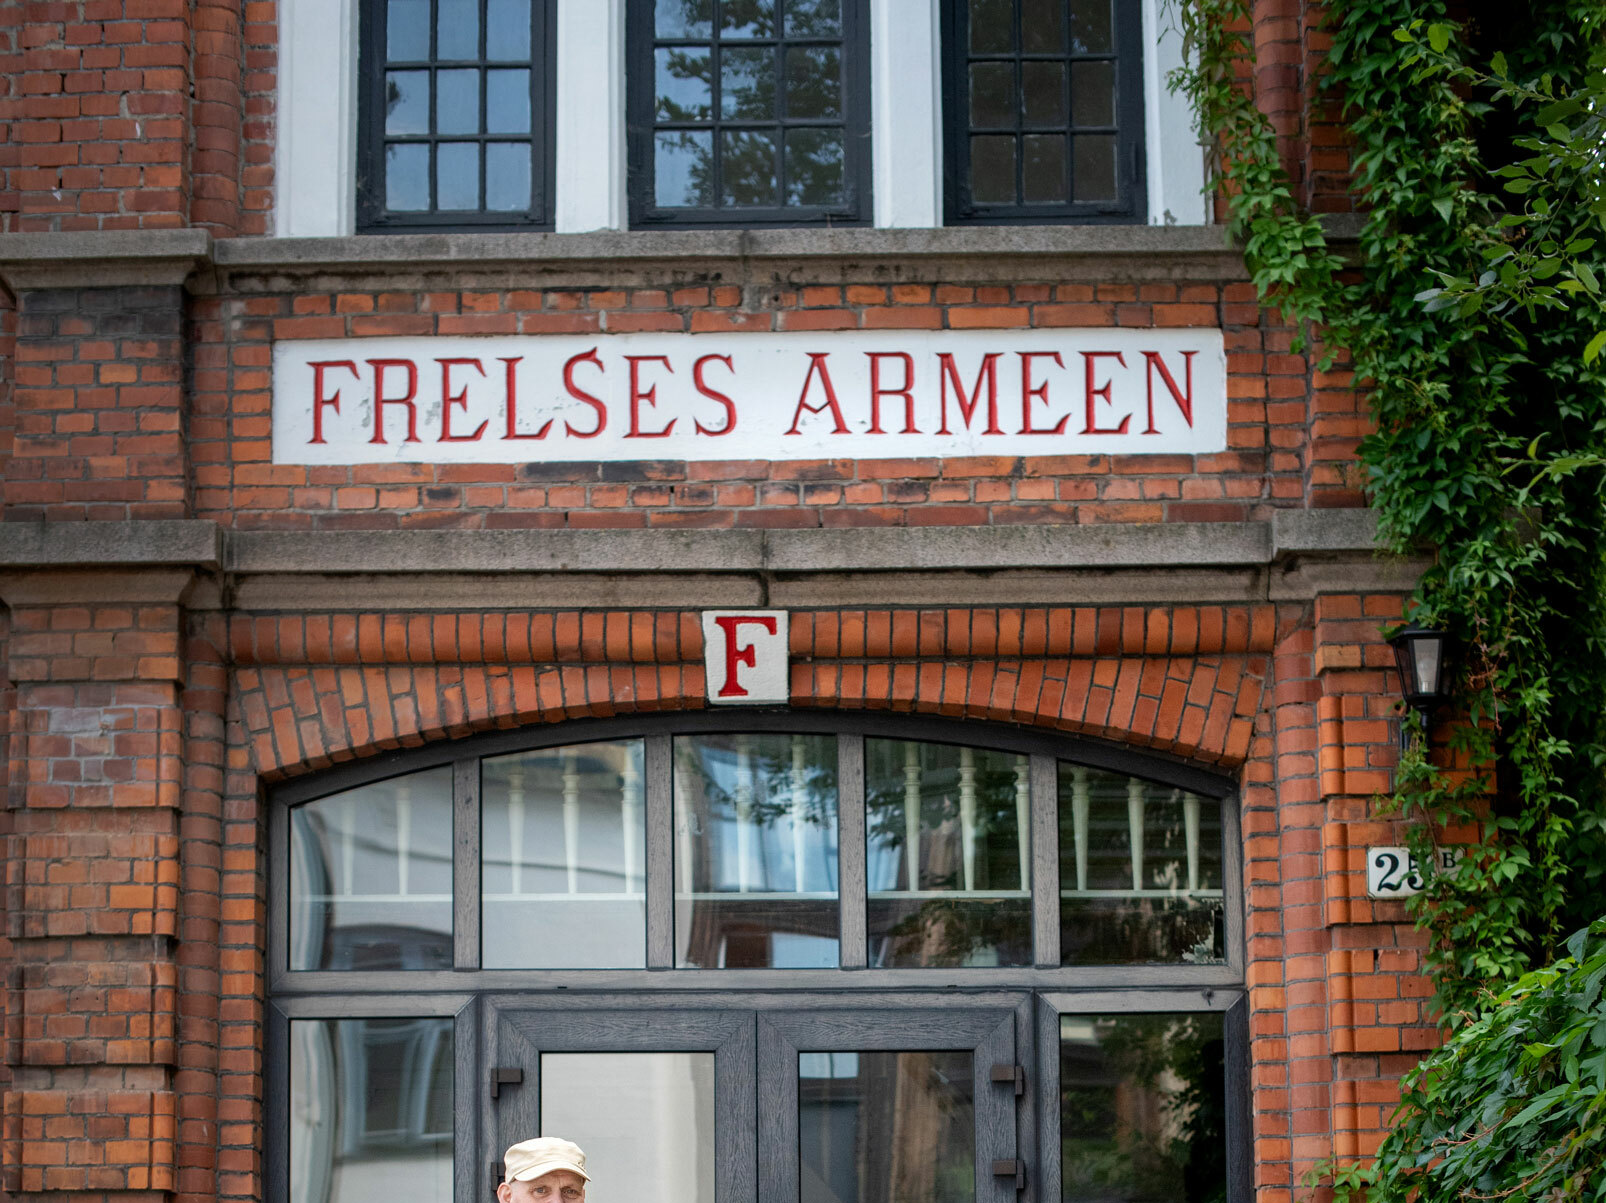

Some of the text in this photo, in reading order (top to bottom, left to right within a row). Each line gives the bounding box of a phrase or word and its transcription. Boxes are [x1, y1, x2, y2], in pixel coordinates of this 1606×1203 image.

[307, 346, 1200, 445] FRELSES ARMEEN
[715, 616, 777, 698] F
